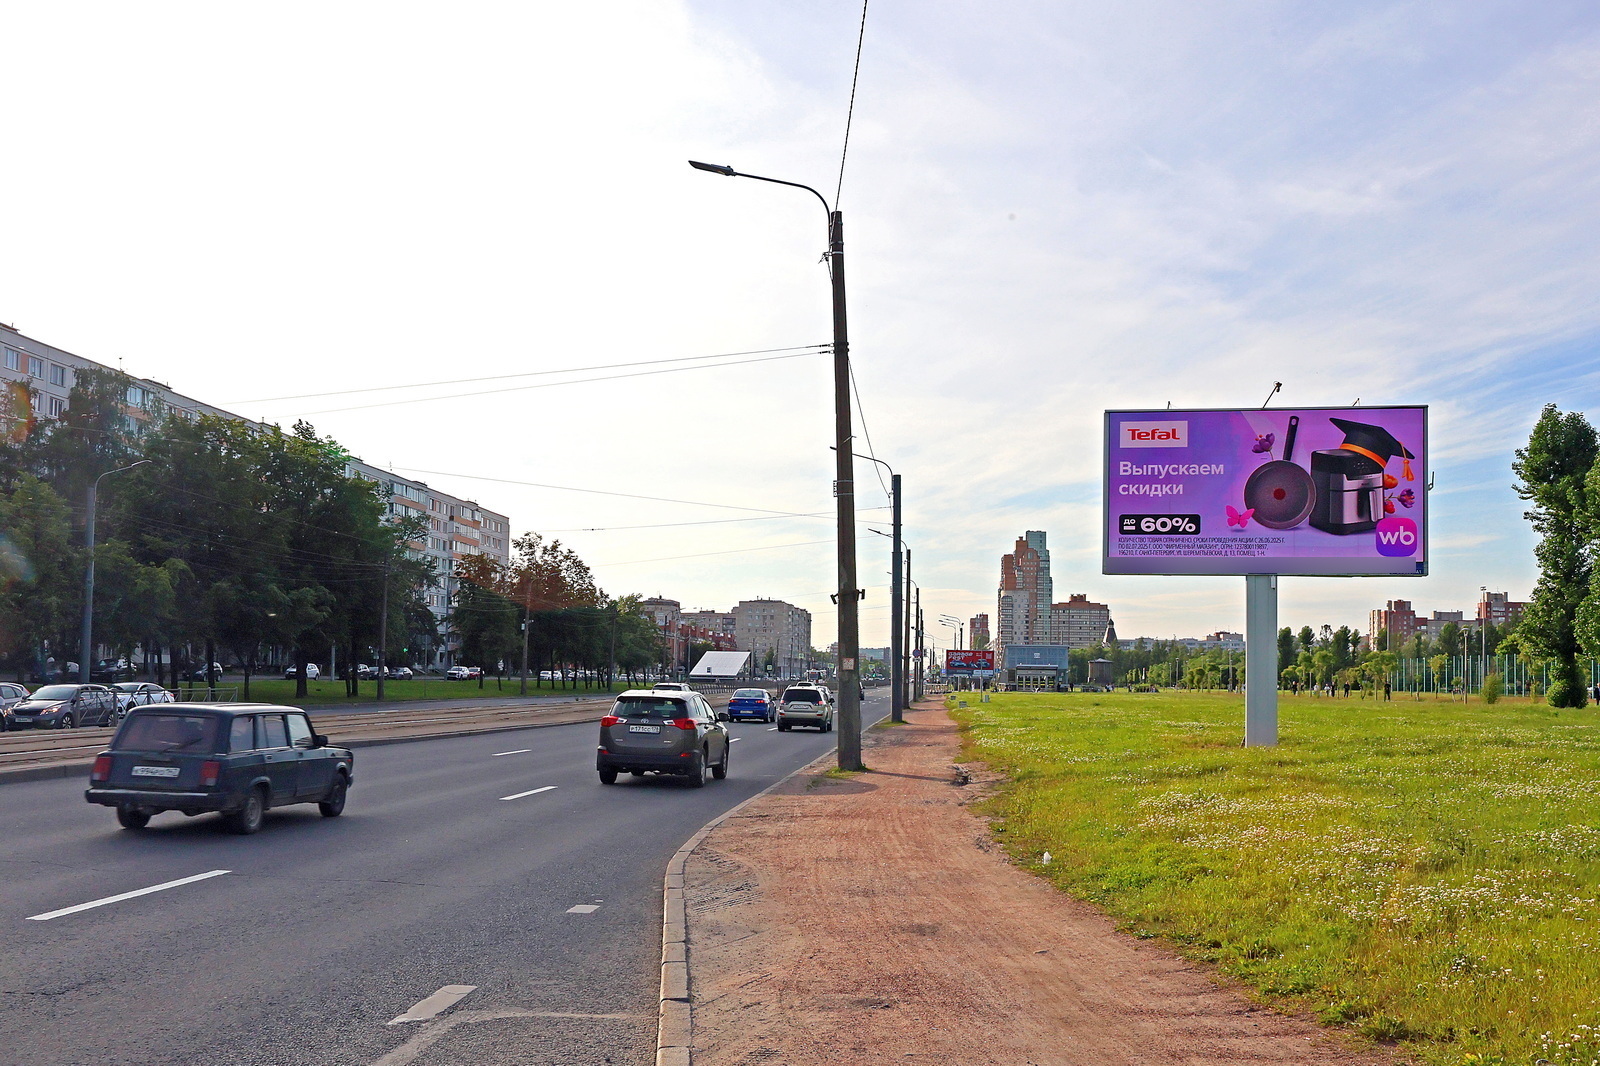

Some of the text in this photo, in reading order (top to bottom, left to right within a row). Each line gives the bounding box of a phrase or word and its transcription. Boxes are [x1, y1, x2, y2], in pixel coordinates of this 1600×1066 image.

[1127, 428, 1181, 441] Tefal
[1119, 461, 1225, 479] Выпускаем
[1119, 484, 1184, 497] скидки
[1140, 517, 1196, 532] 60%
[1378, 525, 1415, 546] wb
